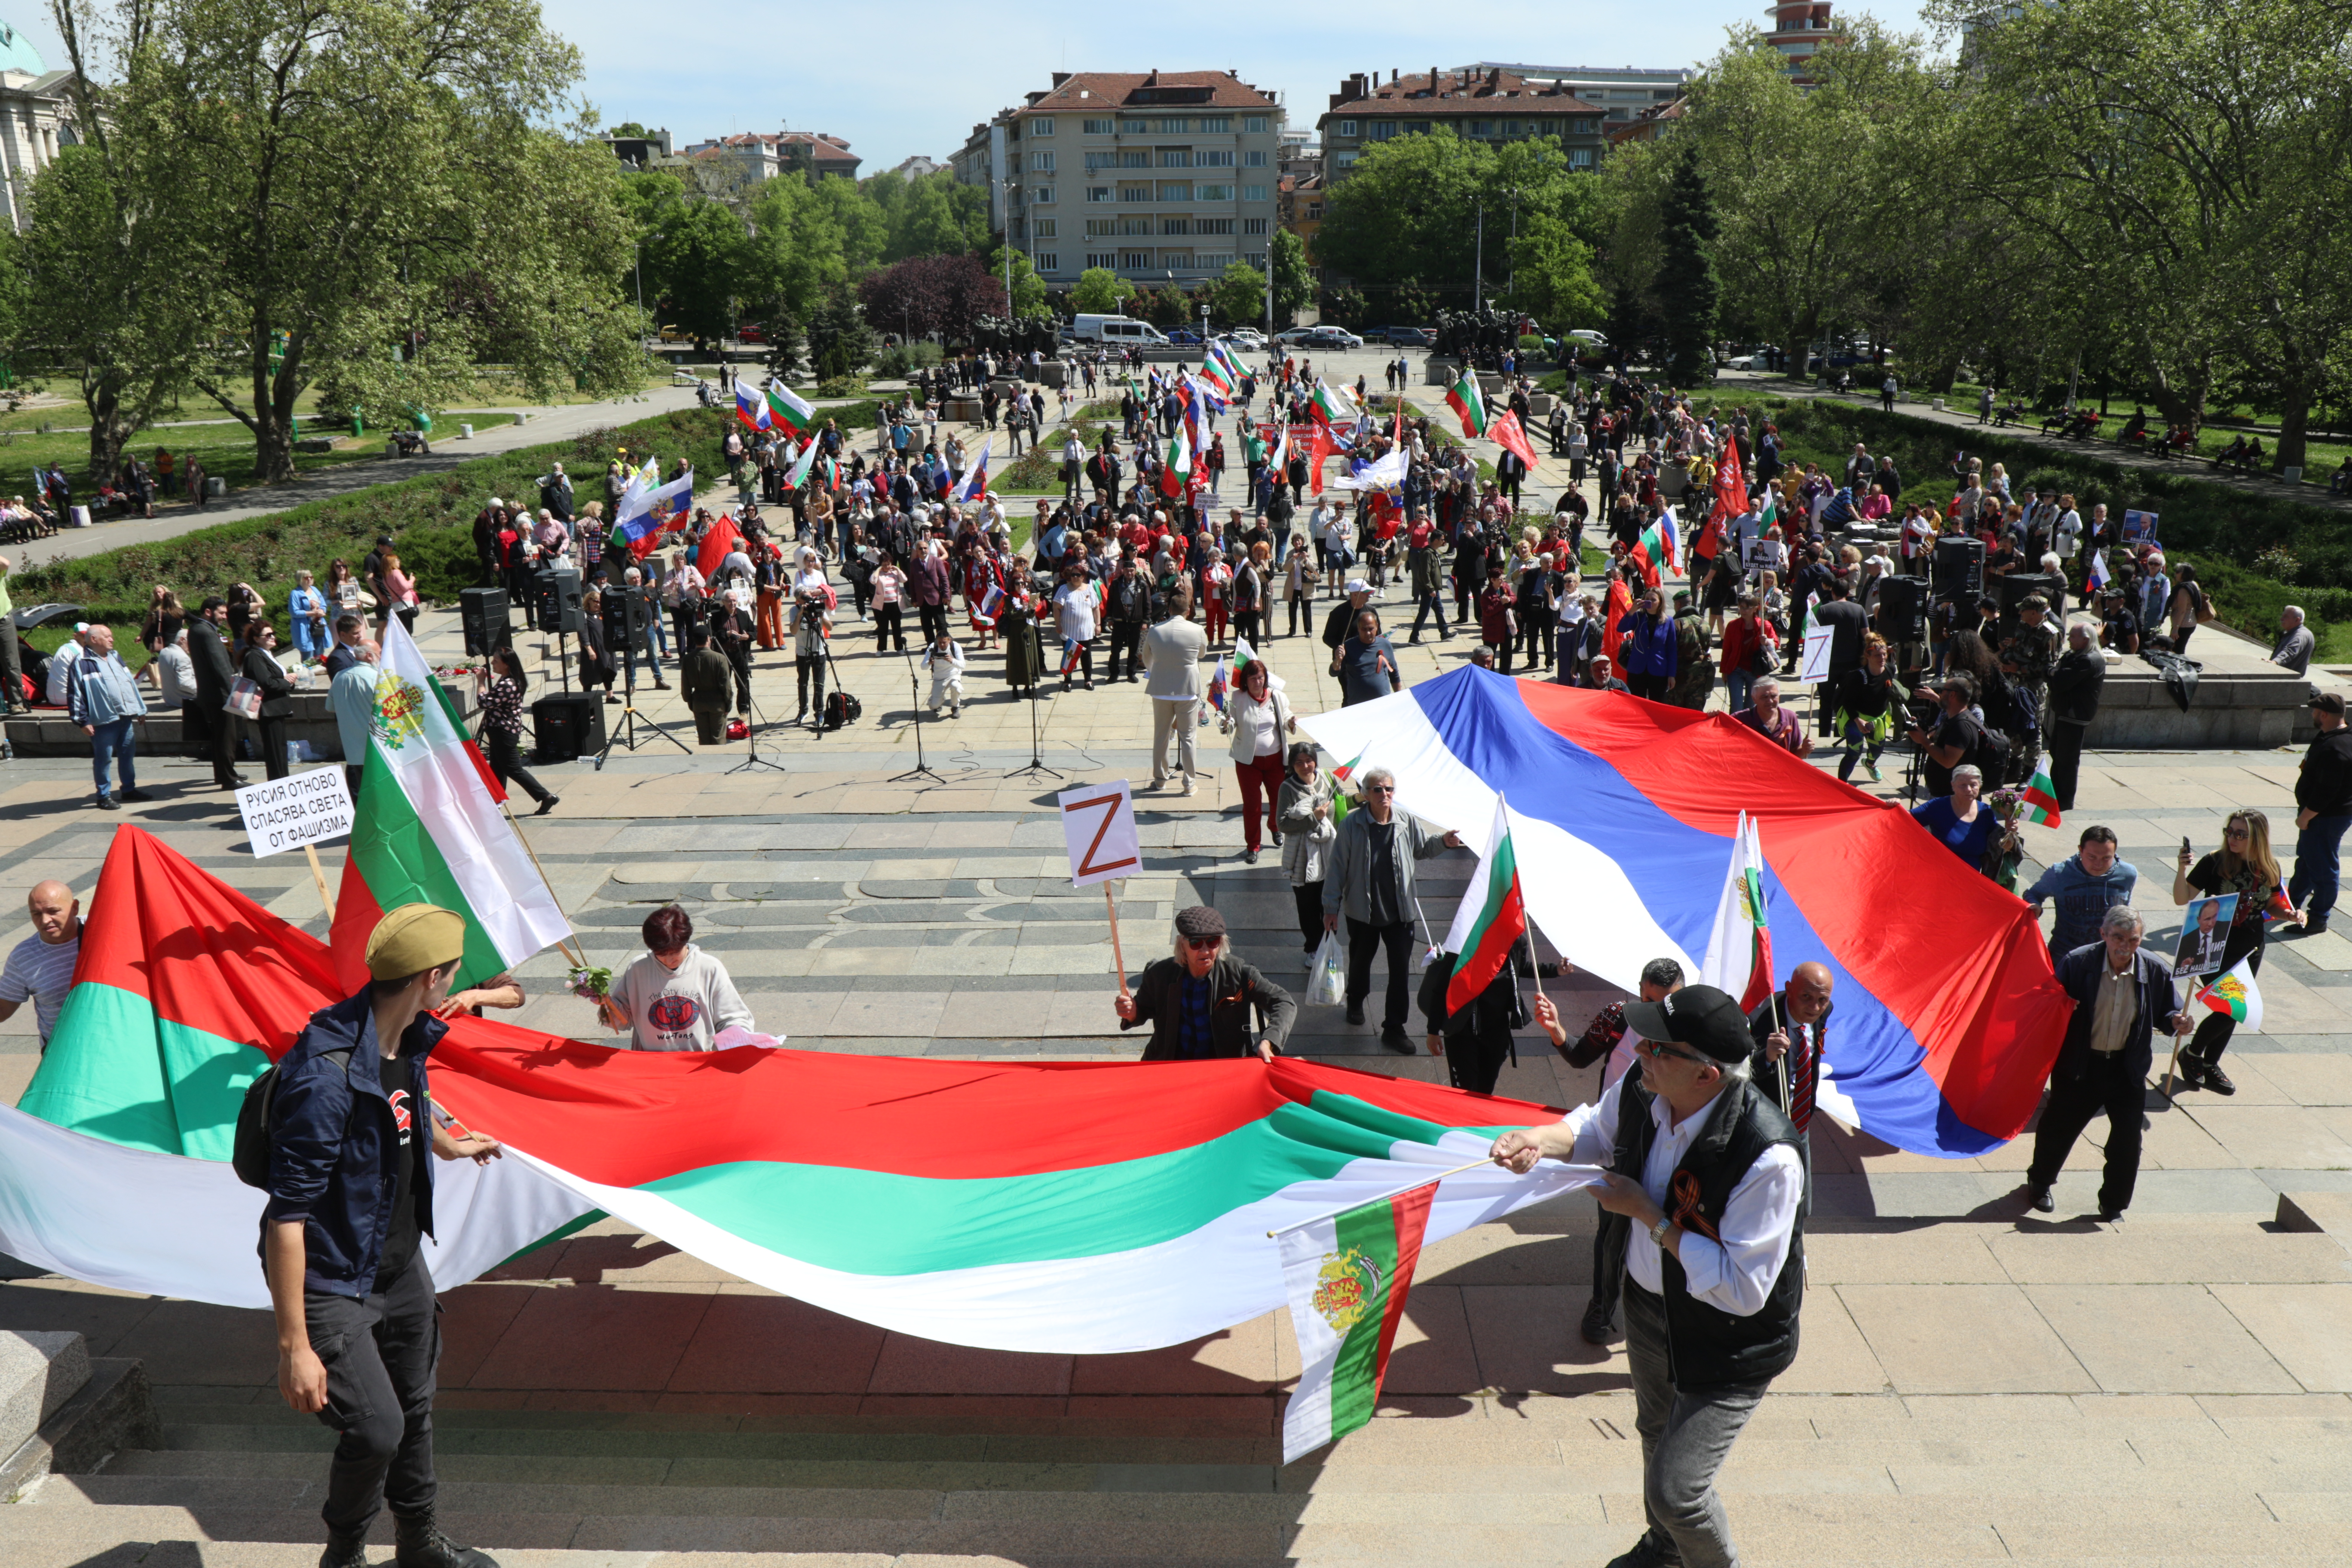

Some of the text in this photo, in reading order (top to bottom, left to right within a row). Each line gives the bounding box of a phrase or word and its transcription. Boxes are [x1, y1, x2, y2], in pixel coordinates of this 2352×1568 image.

[245, 773, 336, 808] РУСИЯ ОТНОВО
[250, 793, 347, 830] СПАСЯВА СВЕТА
[270, 815, 349, 847] ОТ ФАШИЗМА
[1065, 793, 1137, 877] Z
[2206, 940, 2226, 953] МИР
[2175, 960, 2219, 975] БЕZ НАЦИЗМА
[648, 988, 700, 1003] The City is life
[657, 1032, 693, 1040] Wu-Tang
